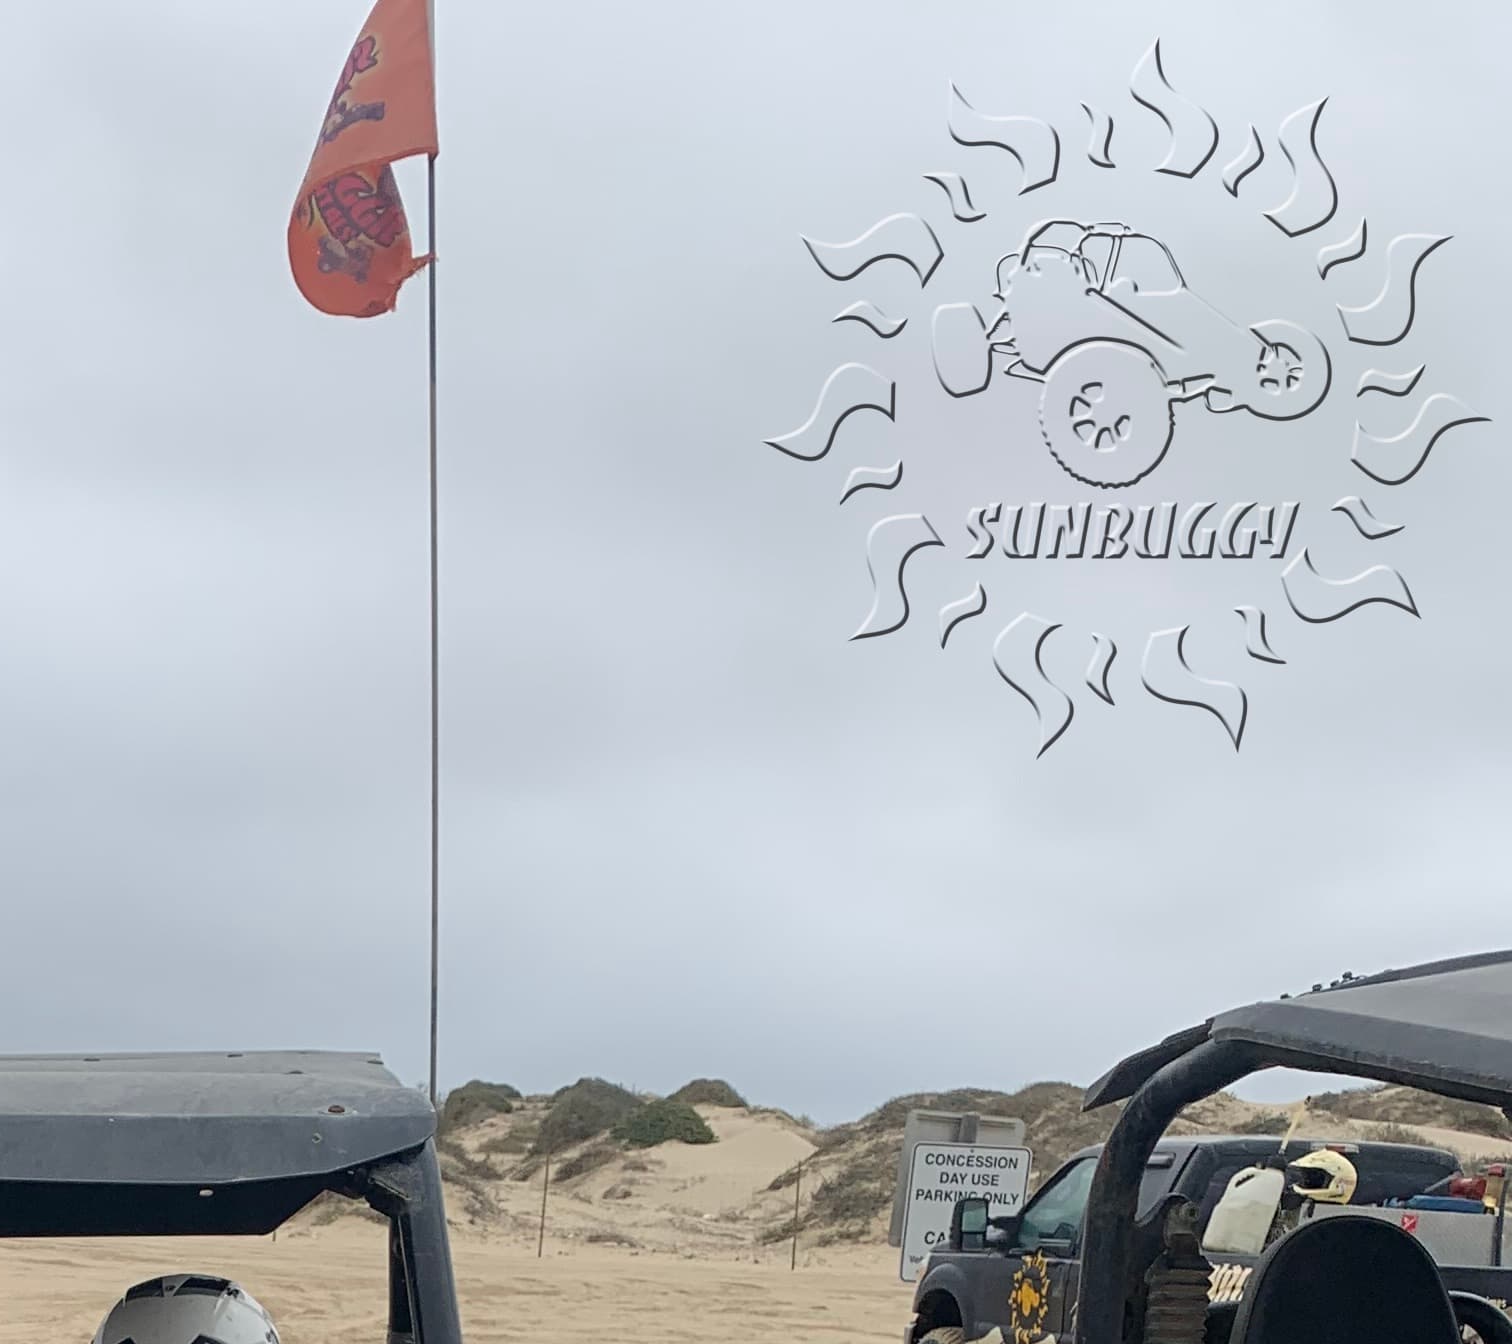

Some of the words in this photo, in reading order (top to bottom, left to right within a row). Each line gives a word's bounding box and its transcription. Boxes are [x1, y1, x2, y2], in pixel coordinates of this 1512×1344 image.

[925, 1153, 1019, 1169] CONCESSION
[939, 1172, 968, 1185] DAY
[971, 1174, 1000, 1186] USE
[983, 1192, 1019, 1205] ONLY
